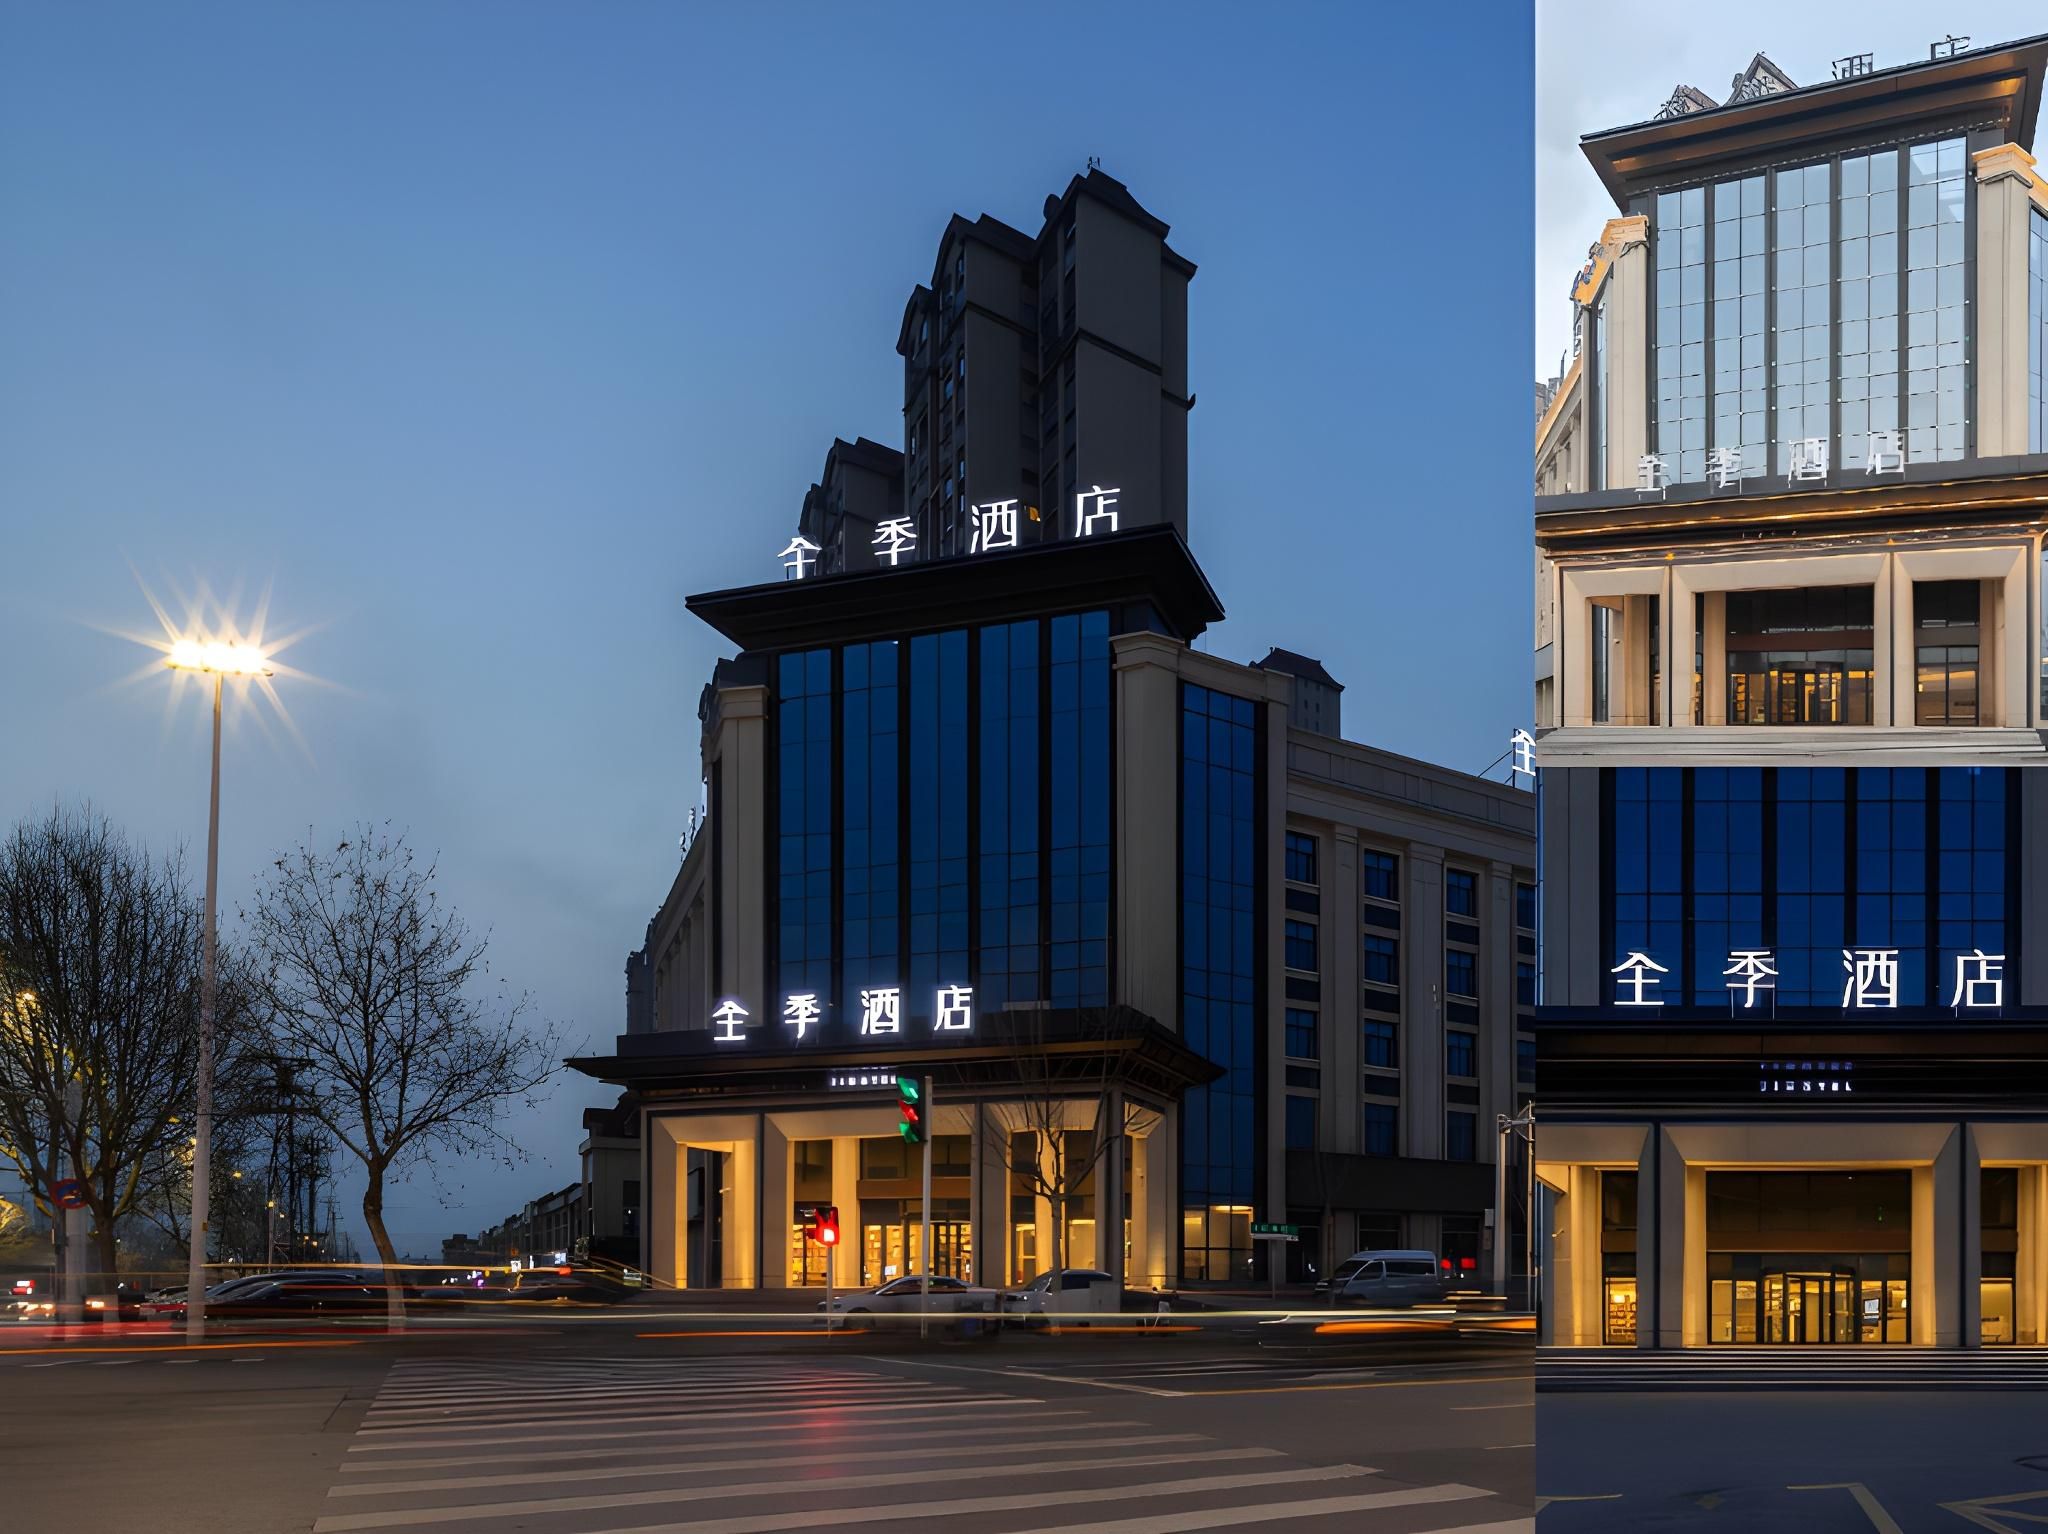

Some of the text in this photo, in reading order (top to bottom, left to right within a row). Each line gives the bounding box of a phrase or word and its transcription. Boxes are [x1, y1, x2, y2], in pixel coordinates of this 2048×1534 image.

[1610, 948, 2006, 1009] 全季酒店
[712, 984, 973, 1041] 全季酒店
